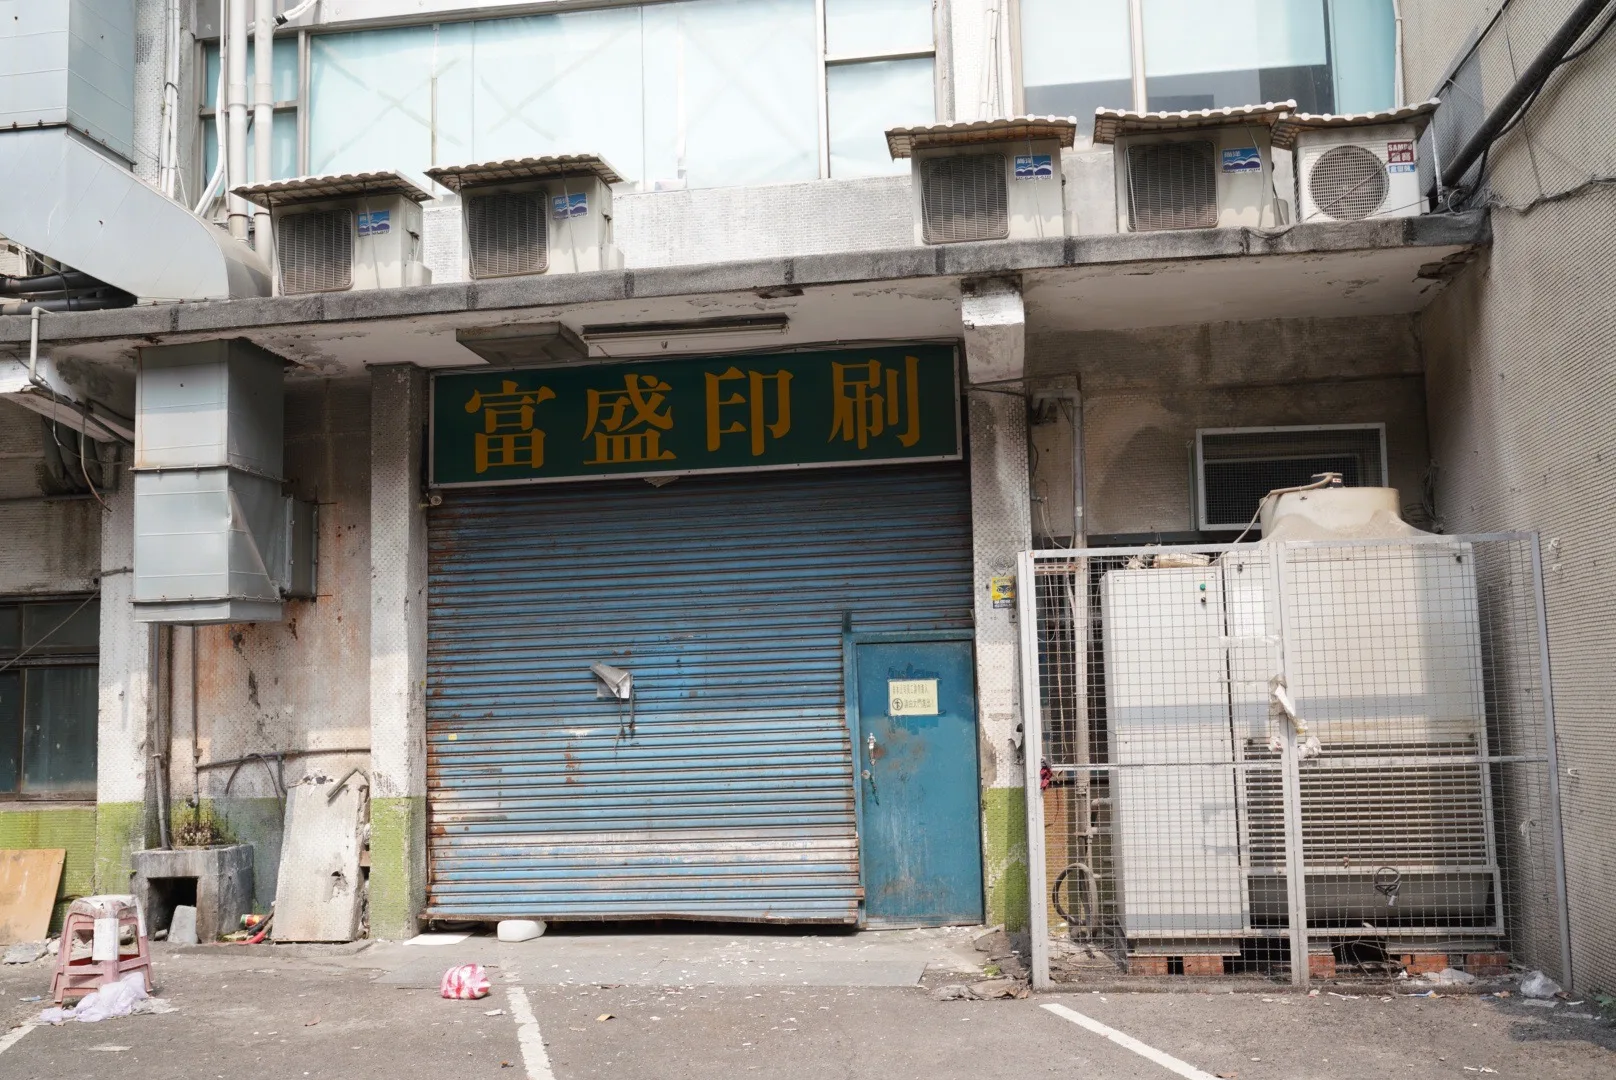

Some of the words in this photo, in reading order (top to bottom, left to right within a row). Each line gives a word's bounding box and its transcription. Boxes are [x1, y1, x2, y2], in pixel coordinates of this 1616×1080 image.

[1388, 143, 1413, 151] SAMPO
[464, 355, 921, 474] 富盛印刷
